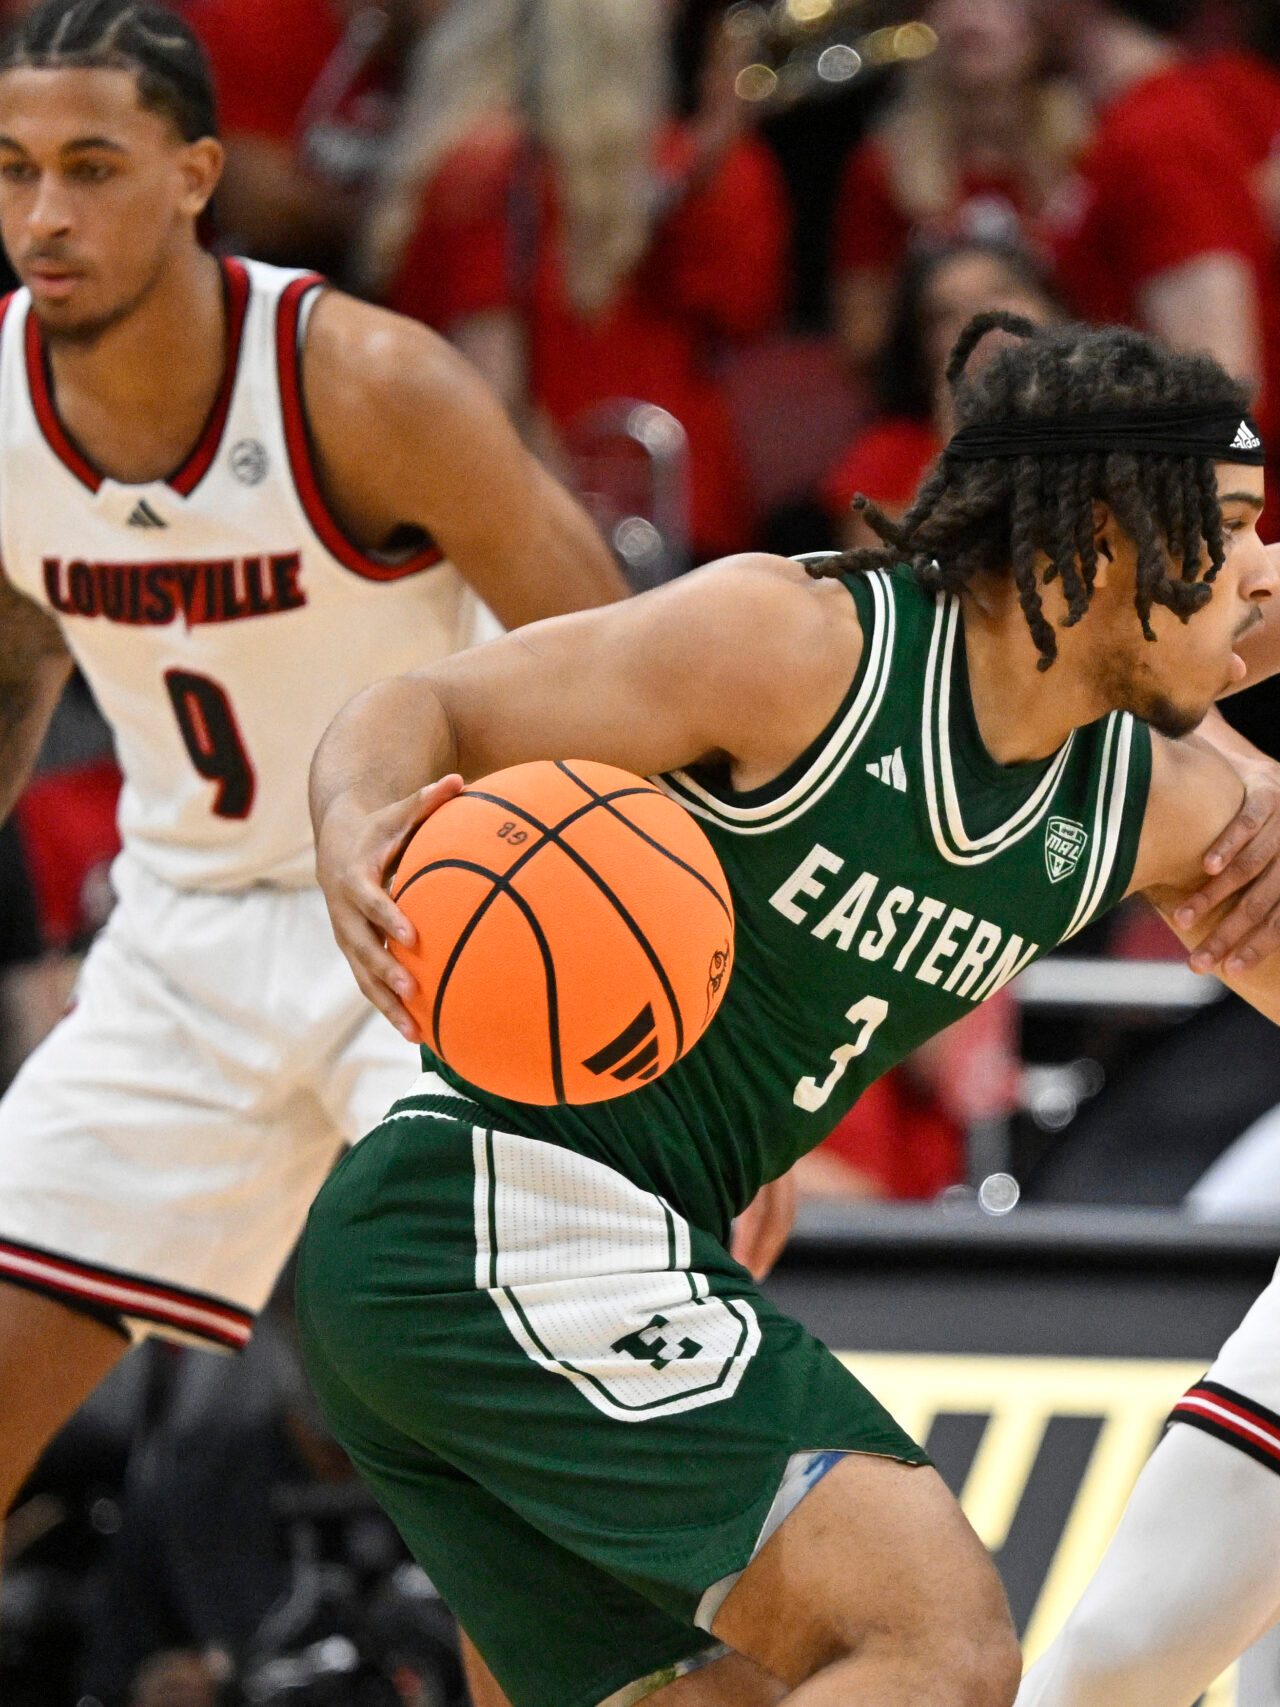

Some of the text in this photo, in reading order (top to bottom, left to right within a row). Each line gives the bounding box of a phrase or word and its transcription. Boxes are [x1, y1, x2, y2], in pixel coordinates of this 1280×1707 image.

[42, 551, 307, 634] LOUISVILLE
[164, 667, 257, 820] 9
[768, 843, 1039, 1002] EASTERN
[792, 995, 889, 1112] 3
